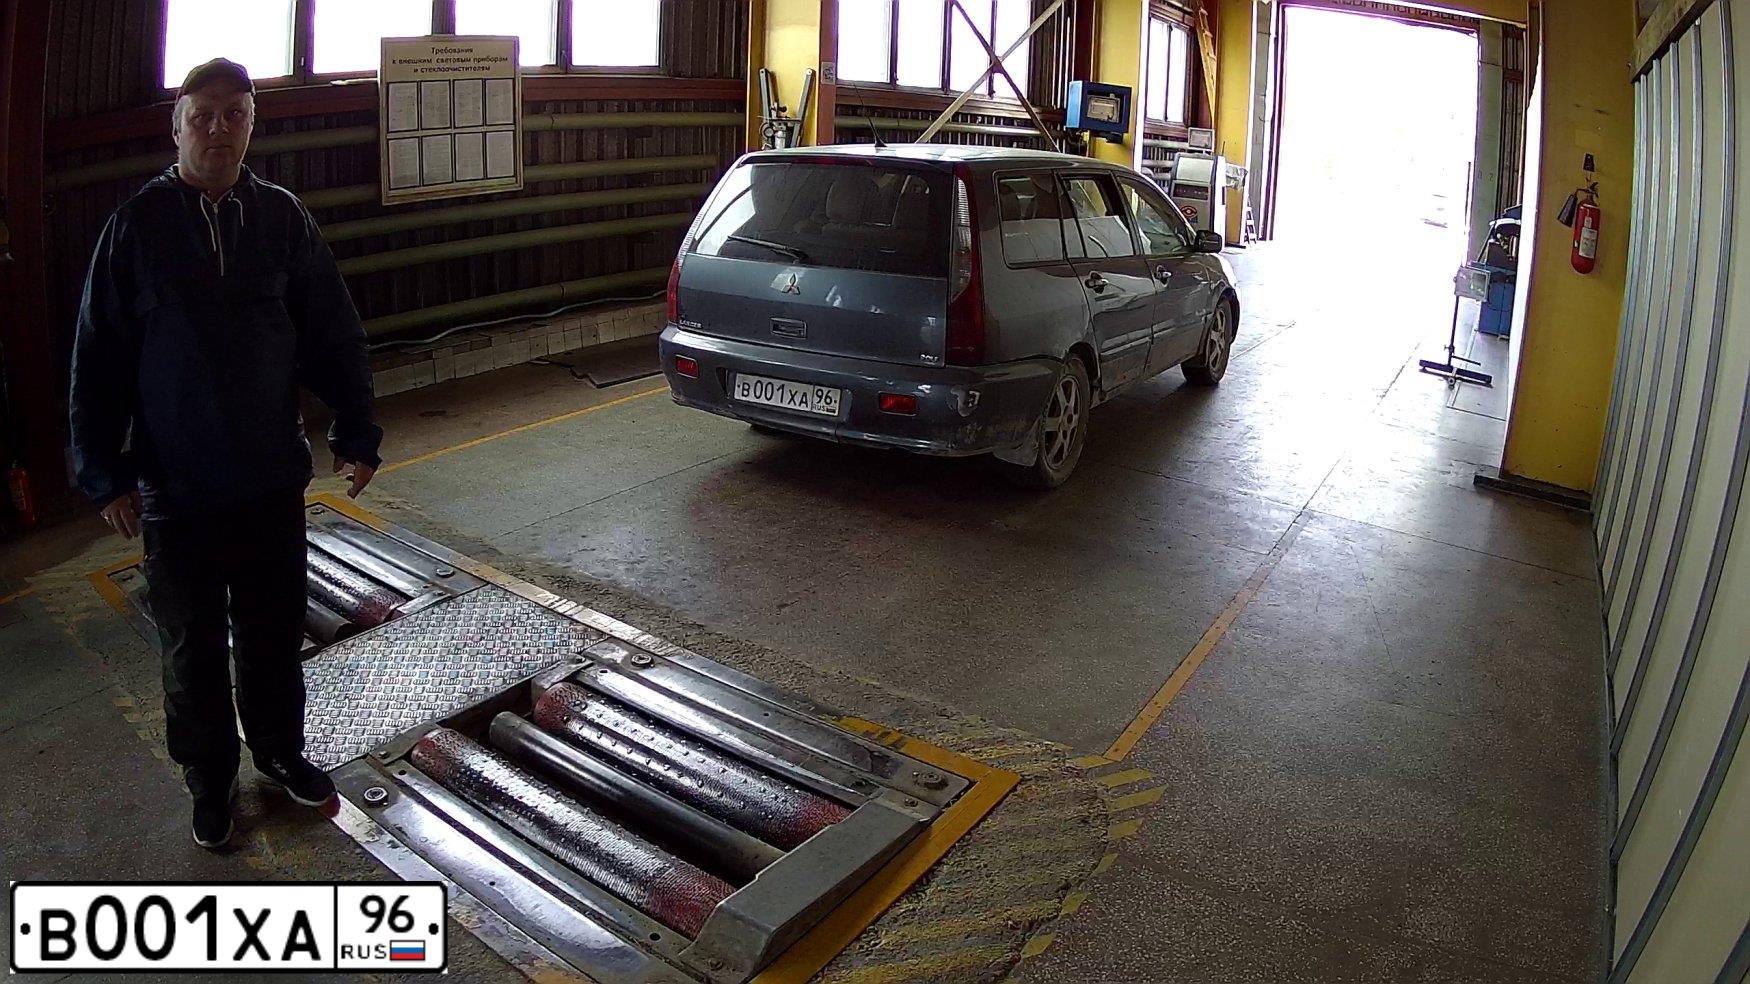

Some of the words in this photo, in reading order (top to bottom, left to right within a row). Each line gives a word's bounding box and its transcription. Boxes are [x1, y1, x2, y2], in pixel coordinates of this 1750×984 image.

[431, 46, 473, 55] Требования
[473, 55, 508, 63] приборам
[420, 66, 491, 74] стеклоочистителям
[741, 379, 808, 408] В001ХА
[815, 388, 833, 405] 96
[813, 403, 826, 412] RUS
